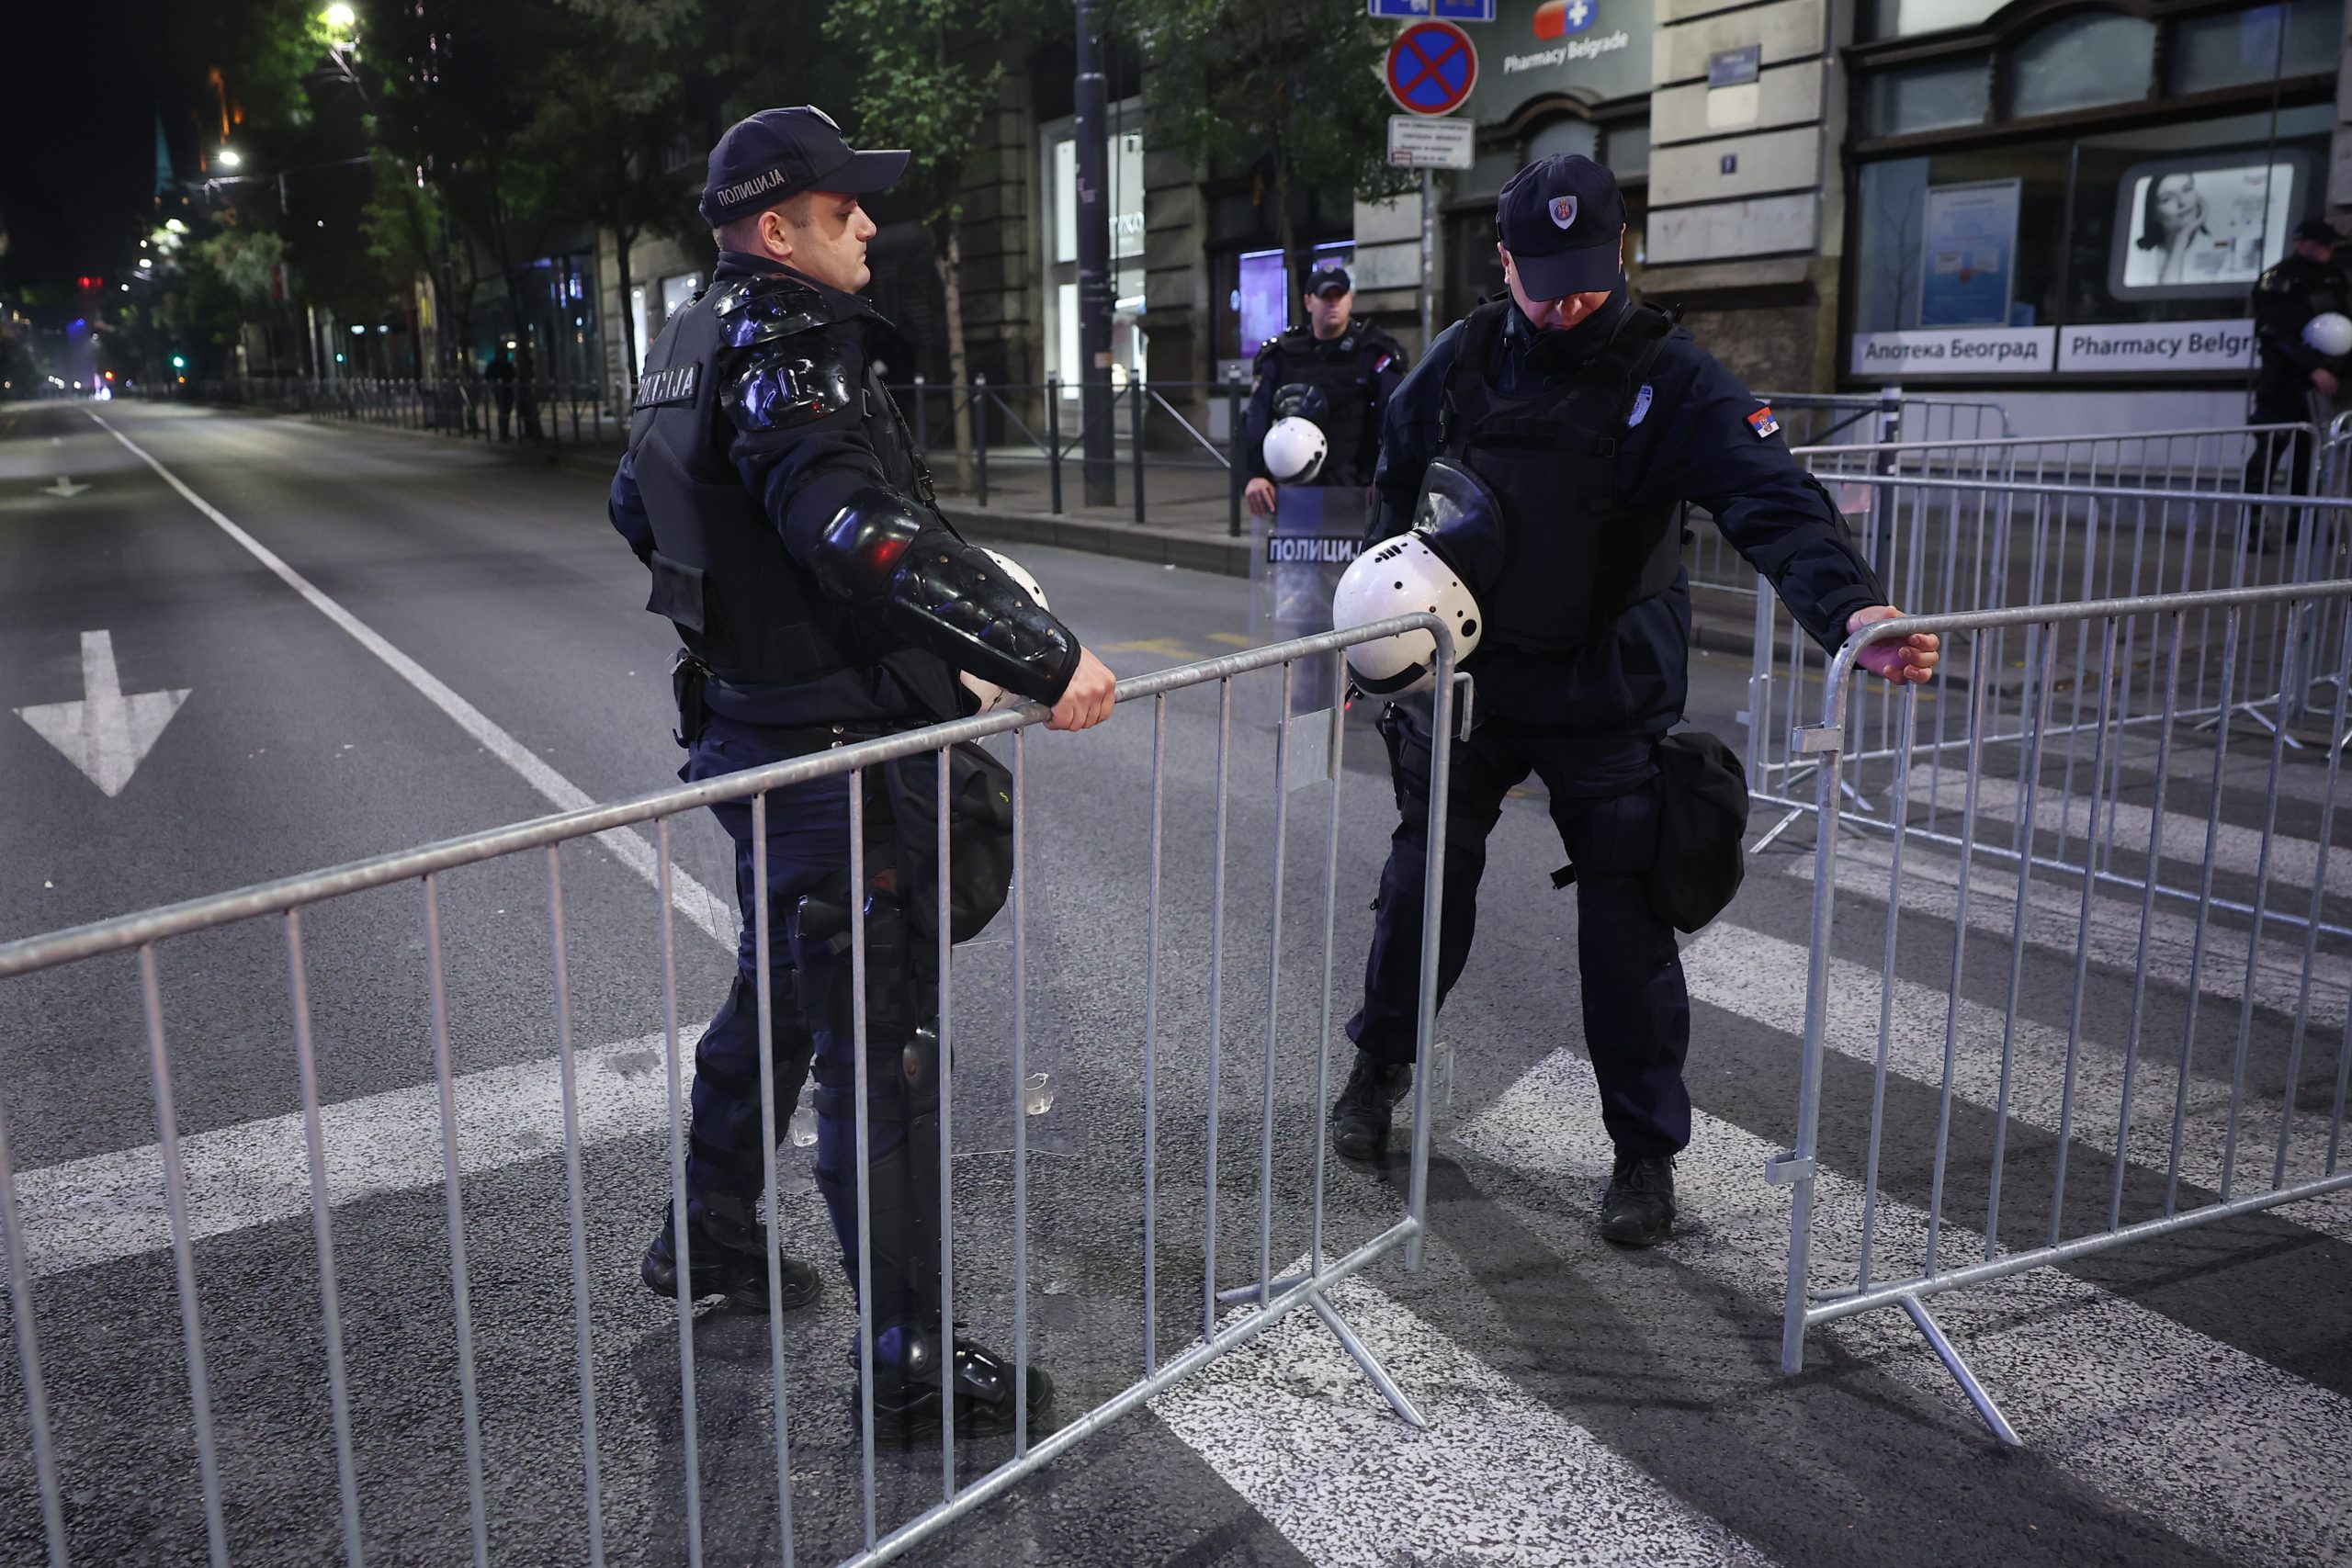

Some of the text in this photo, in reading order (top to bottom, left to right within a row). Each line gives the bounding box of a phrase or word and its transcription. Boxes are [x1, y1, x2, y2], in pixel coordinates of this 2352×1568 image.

[1503, 28, 1629, 74] Pharmacy Belgrade
[717, 168, 786, 207] ПОЛИЦИЈА
[1864, 338, 2039, 362] Апотека Београд
[2071, 335, 2183, 360] Pharmacy
